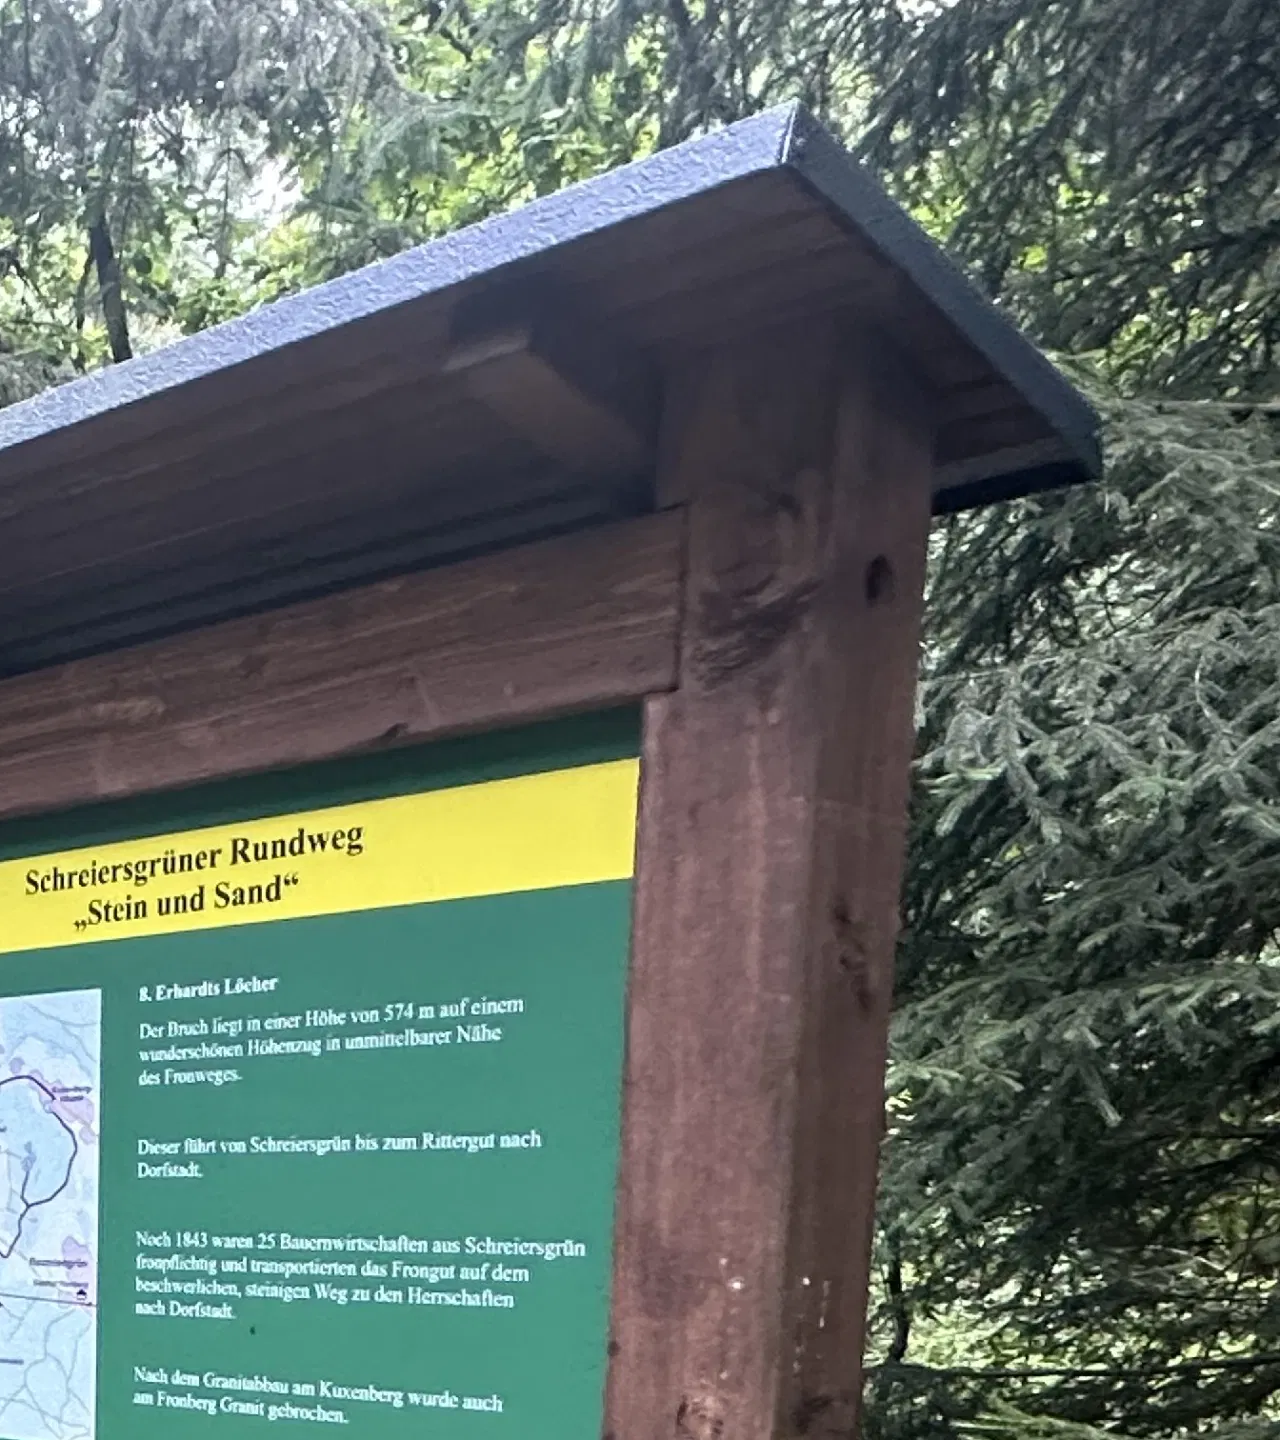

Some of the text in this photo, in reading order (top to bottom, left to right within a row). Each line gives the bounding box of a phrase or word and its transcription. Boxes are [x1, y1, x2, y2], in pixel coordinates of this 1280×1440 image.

[25, 826, 363, 895] Schreiersgrüner Rundweg
[157, 884, 205, 916] und
[155, 980, 220, 1001] Erhardts
[223, 975, 278, 995] Löcher
[139, 996, 523, 1039] Der Bruch liegt in einer Höhe von 574 m auf einem
[138, 1022, 502, 1062] wunderschönen Höhenzug in unmittelbarer Nähe
[138, 1067, 242, 1086] des Fronweges.
[137, 1129, 542, 1156] Dieser führt von Schreiersgrün bis zum Rittergut nach
[137, 1160, 203, 1178] Dorfstadt.
[135, 1230, 586, 1261] Noch 1843 waren 25 Bauernwirtschaften aus Schreiersgrün
[220, 1256, 247, 1272] und
[249, 1258, 357, 1279] transportierten
[360, 1259, 388, 1277] das
[391, 1259, 455, 1283] Frongut
[459, 1261, 490, 1281] auf
[490, 1262, 529, 1281] dem
[134, 1275, 514, 1308] beschwerlichen, steinigen Weg zu den Herrschaften
[134, 1298, 235, 1319] nach Dorfstadt.
[133, 1365, 503, 1412] Nach dem Granitabbau am Kuxenberg wurde auch
[132, 1390, 349, 1424] am Fronberg Granit gebrochen.
